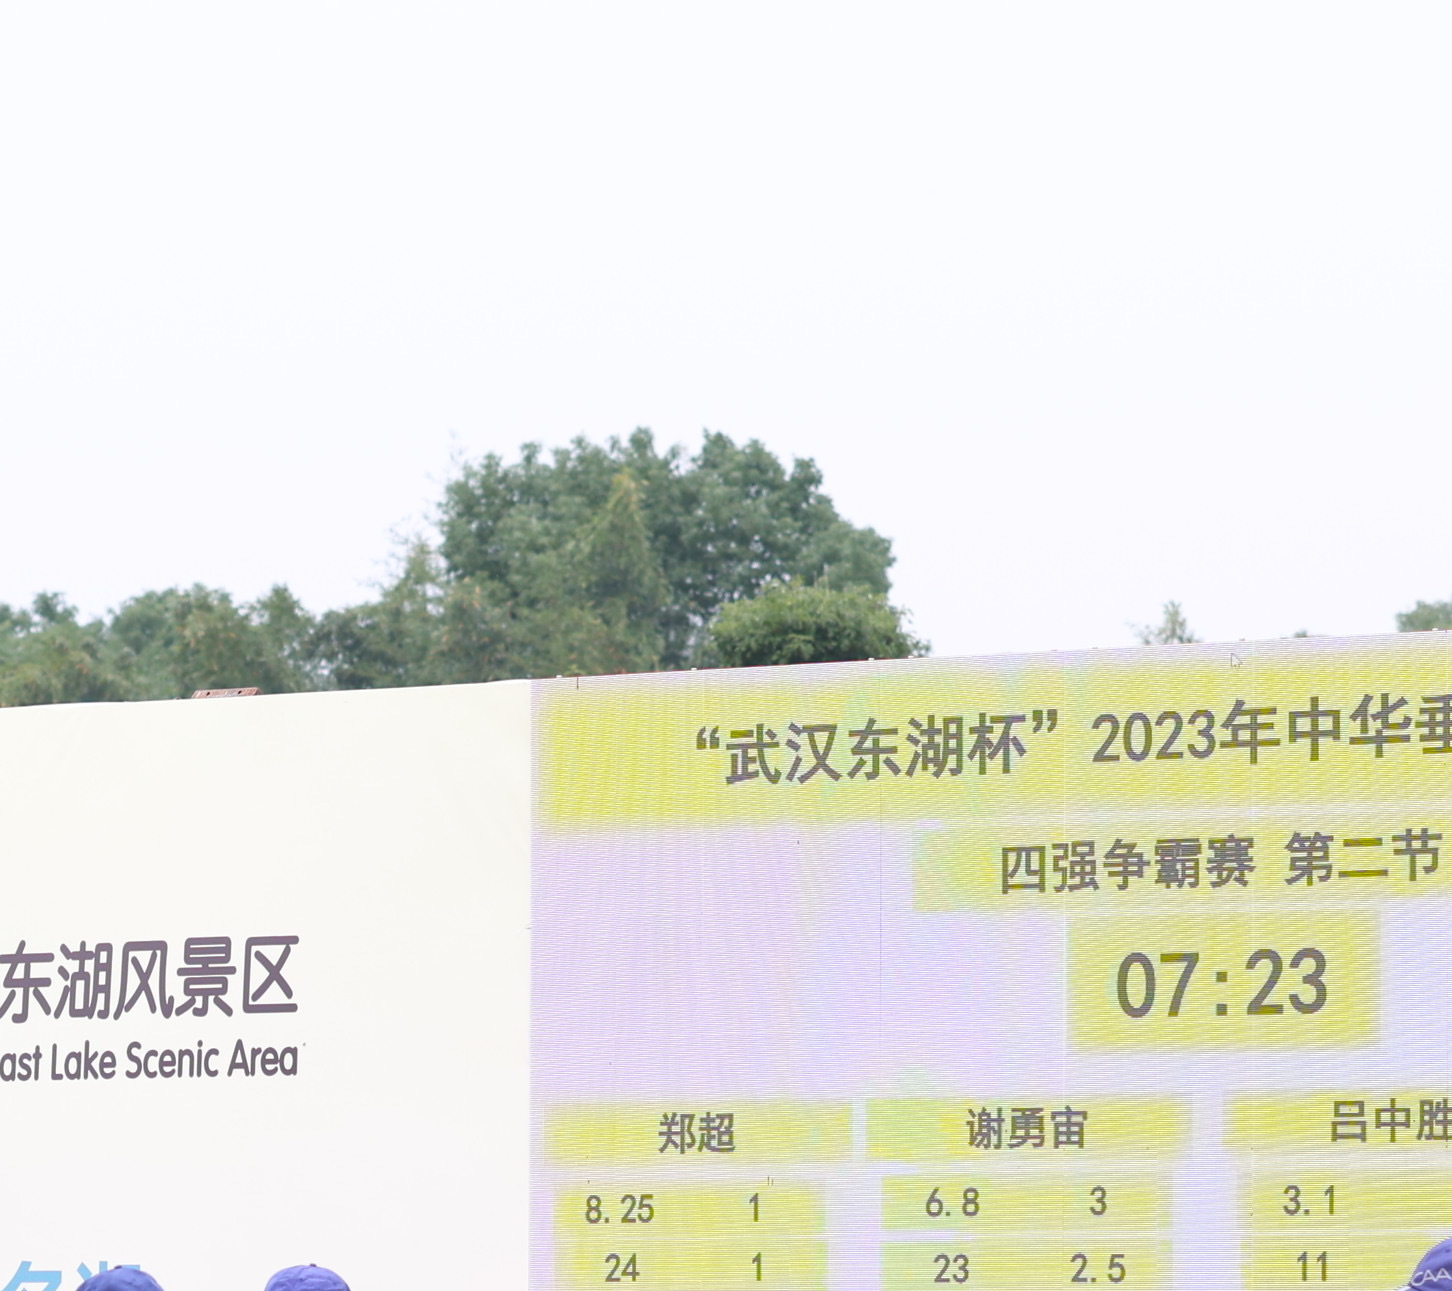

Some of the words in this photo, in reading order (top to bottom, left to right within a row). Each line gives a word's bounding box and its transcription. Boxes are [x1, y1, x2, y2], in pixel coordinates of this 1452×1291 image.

[998, 834, 1256, 896] 四强争霸赛
[1284, 825, 1444, 886] 第二节
[1115, 945, 1331, 1021] 07:23
[51, 1040, 116, 1080] Lake
[126, 1040, 219, 1079] Scenic
[227, 1039, 298, 1077] Area
[658, 1111, 737, 1155] 郑超
[584, 1193, 655, 1225] 8.25
[748, 1192, 761, 1222] 1
[924, 1187, 980, 1217] 6.8
[1088, 1185, 1107, 1216] 3
[1282, 1185, 1336, 1216] 3.1
[604, 1253, 640, 1283] 24
[751, 1252, 763, 1282] 1
[933, 1253, 969, 1283] 23
[1069, 1252, 1126, 1283] 2.5
[1296, 1251, 1329, 1282] 11
[1410, 1267, 1452, 1287] CAA
